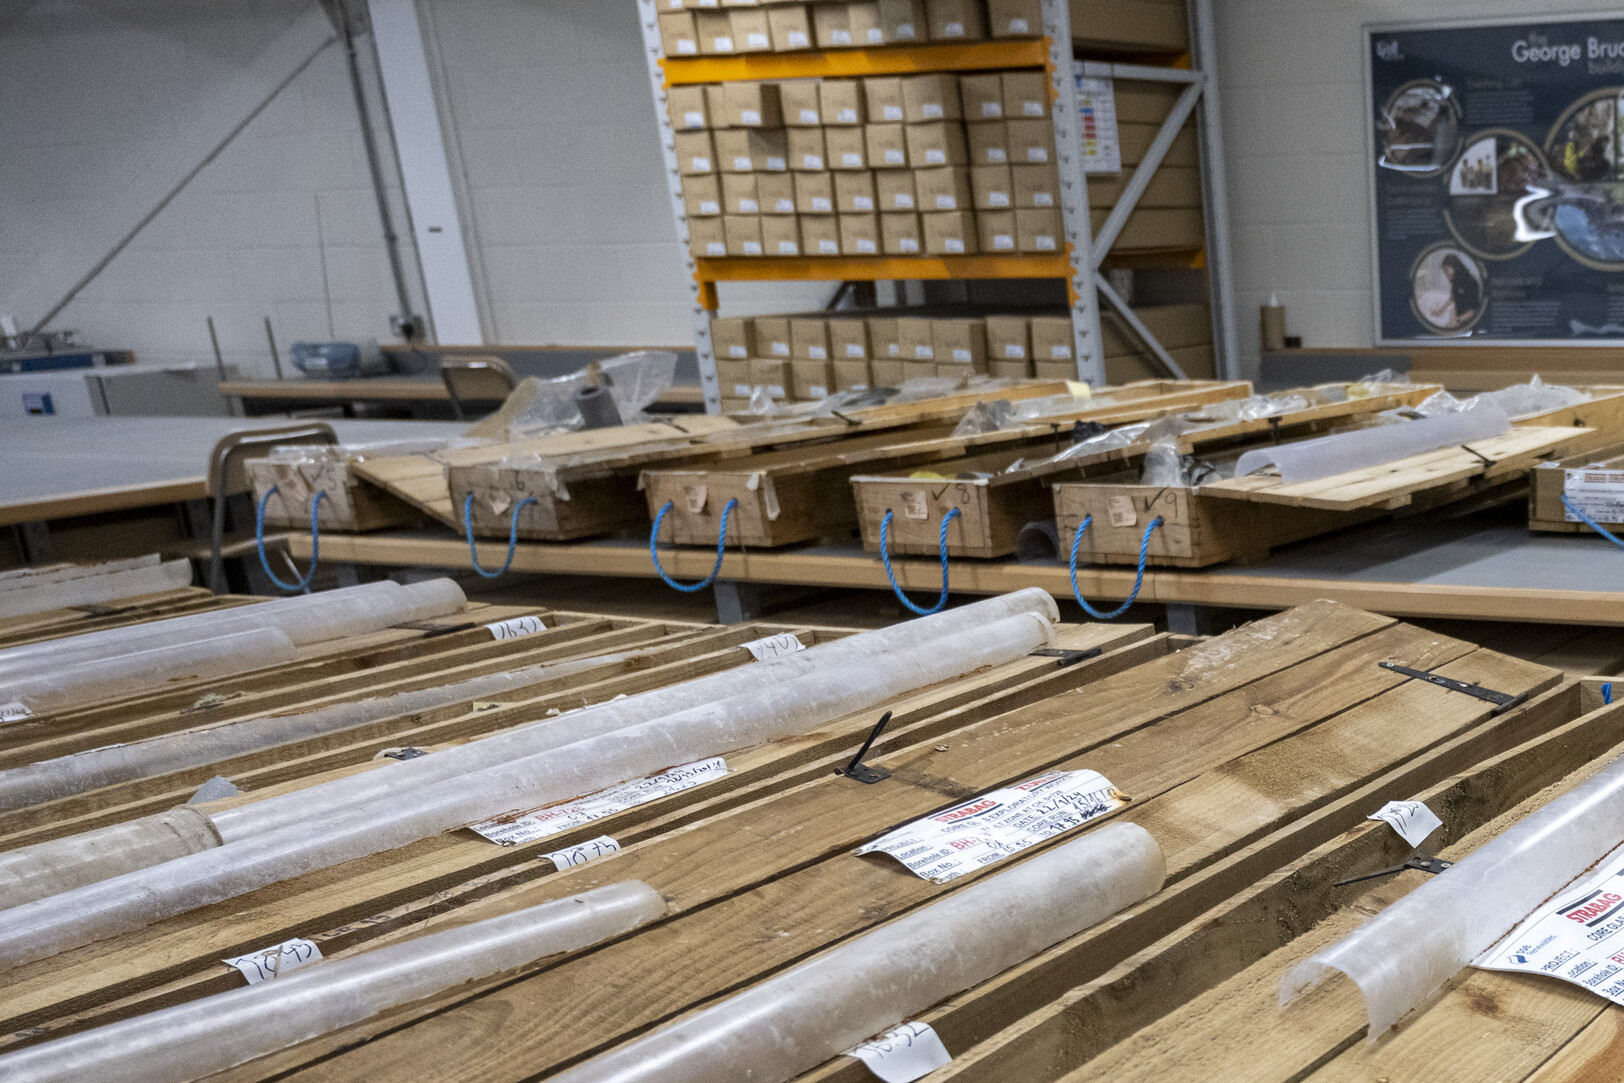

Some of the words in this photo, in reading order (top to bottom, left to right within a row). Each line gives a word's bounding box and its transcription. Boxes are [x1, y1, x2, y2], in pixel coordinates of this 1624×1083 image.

[1511, 39, 1581, 67] George
[935, 799, 997, 824] STRABAG
[907, 851, 940, 870] Borehole
[1013, 813, 1039, 828] DATE:
[919, 866, 938, 879] Box
[1026, 818, 1052, 832] CORE
[1566, 892, 1623, 924] STRABAG
[1586, 926, 1613, 942] CORE
